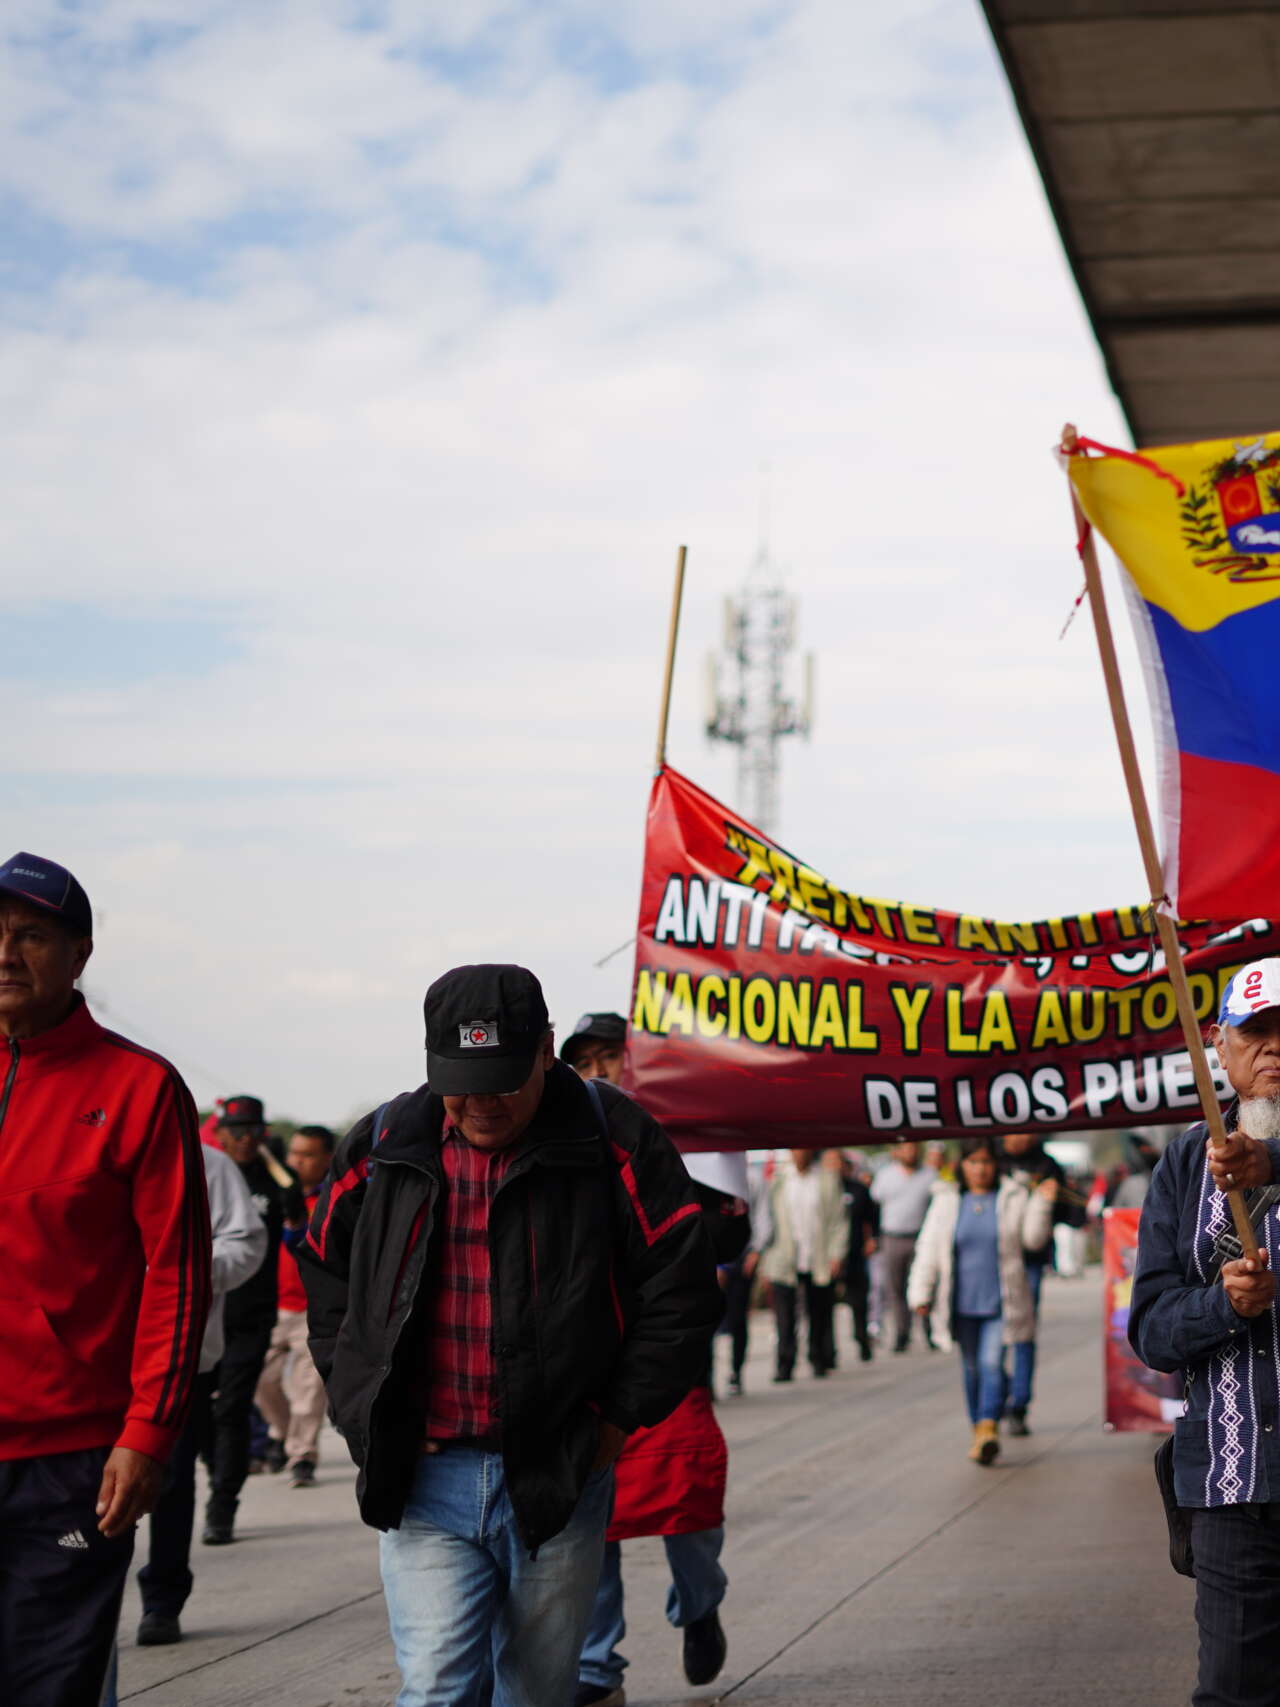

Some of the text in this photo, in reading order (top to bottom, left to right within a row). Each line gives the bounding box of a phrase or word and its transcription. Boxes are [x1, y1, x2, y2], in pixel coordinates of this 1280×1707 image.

[655, 878, 770, 947] ANTI
[957, 905, 1097, 952] ANTI
[634, 970, 877, 1050] NACIONAL
[891, 988, 930, 1051] Y
[947, 990, 1016, 1051] LA
[866, 1080, 939, 1129] DE
[958, 1067, 1067, 1126] LOS
